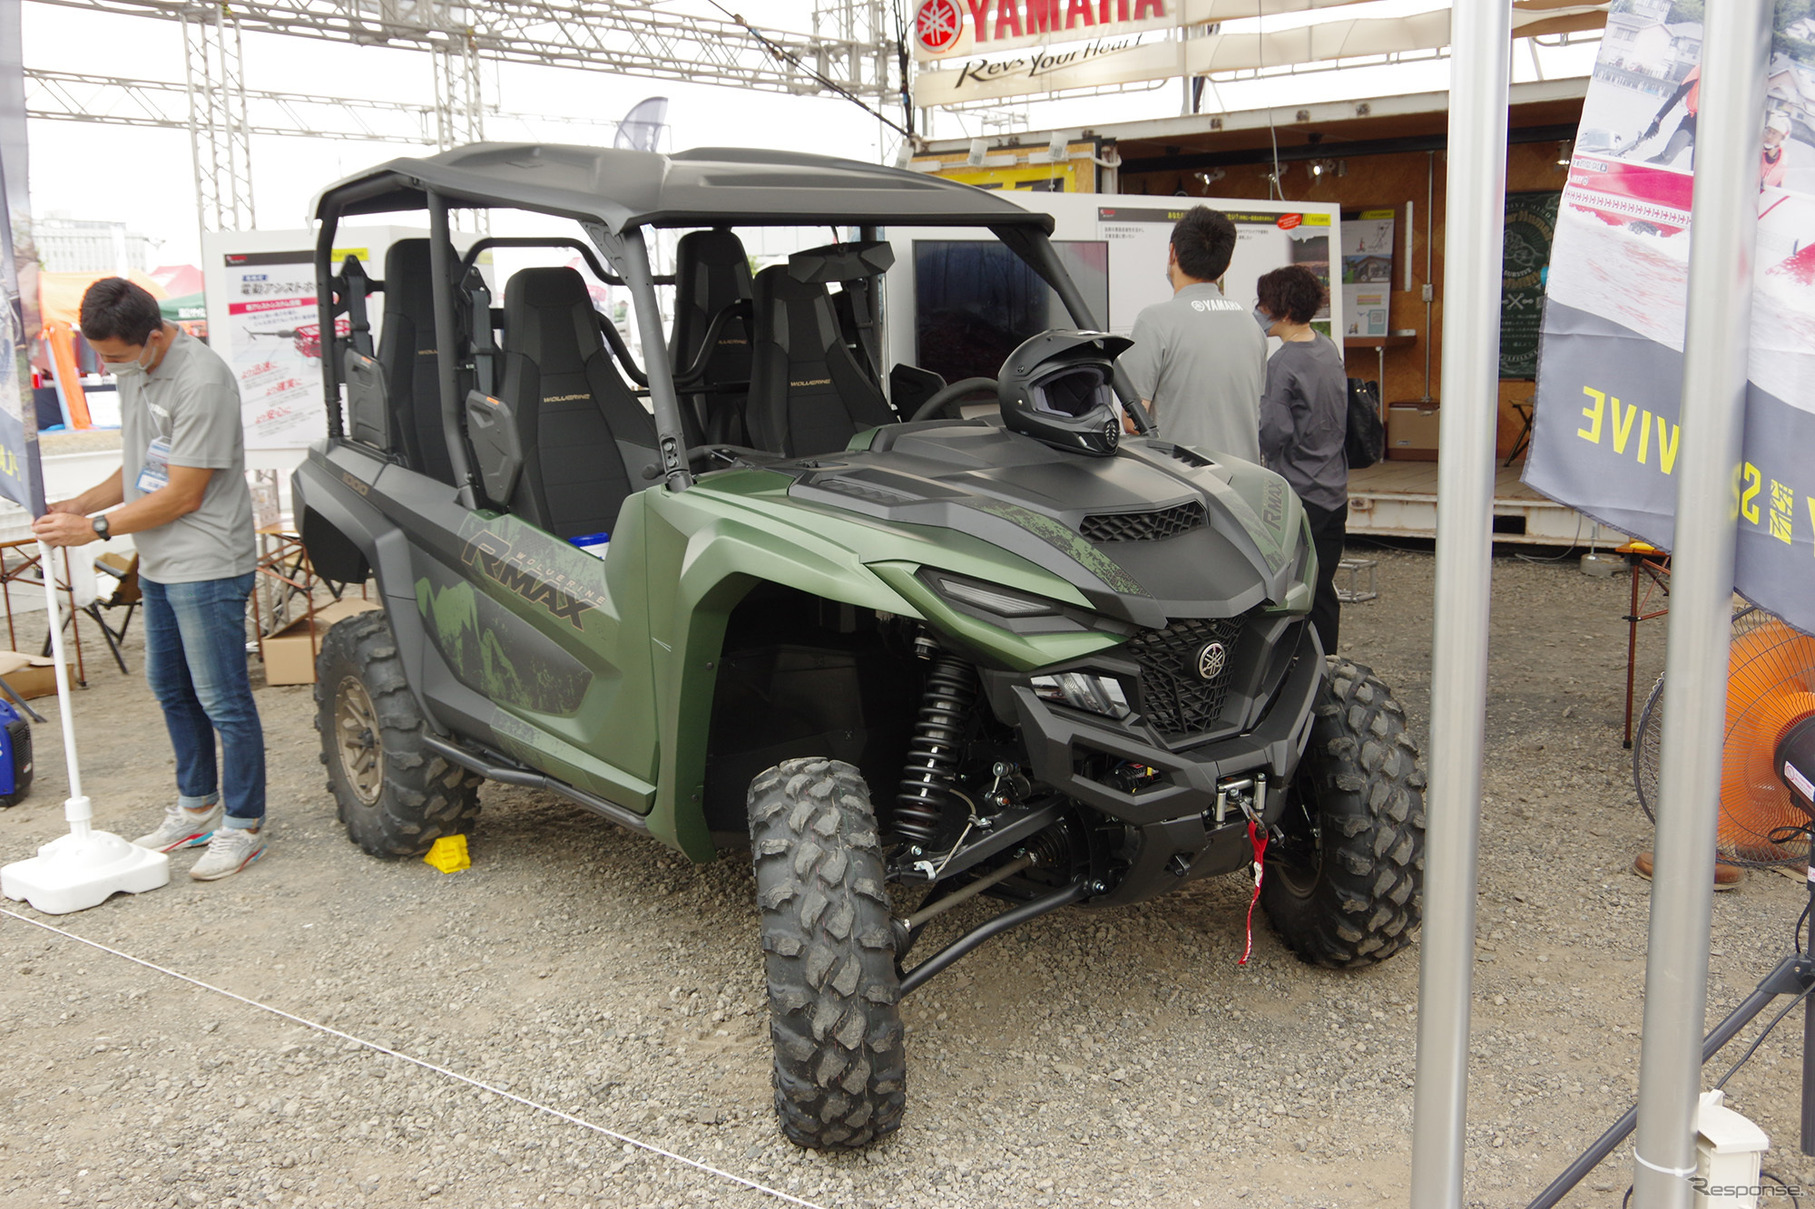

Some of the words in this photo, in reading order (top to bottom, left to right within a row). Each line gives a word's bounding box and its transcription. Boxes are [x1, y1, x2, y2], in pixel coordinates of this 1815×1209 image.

[955, 58, 1024, 89] Revs
[1028, 50, 1081, 77] Your
[1202, 299, 1244, 311] YAMAHA
[1263, 480, 1283, 532] RMAX
[460, 529, 601, 632] RMAX
[515, 551, 606, 605] WOLVERINE
